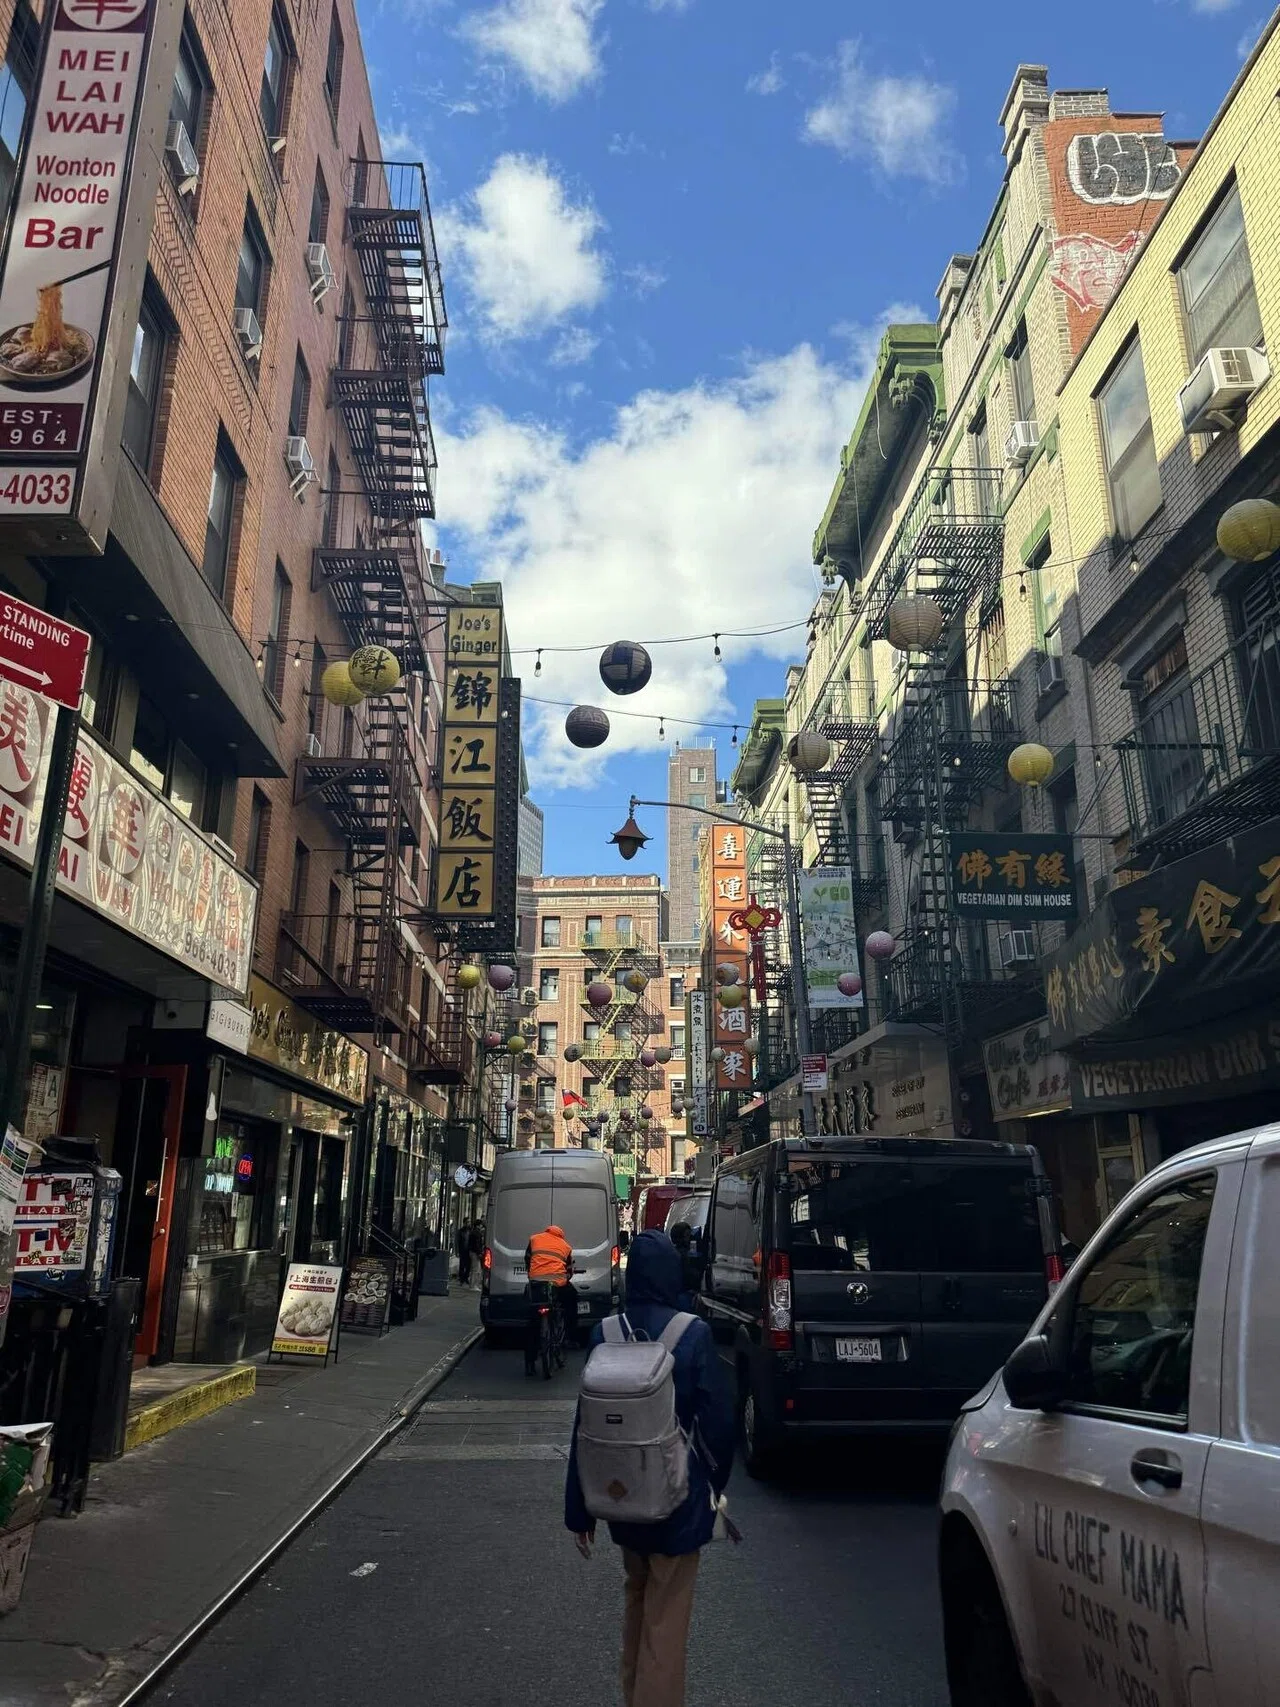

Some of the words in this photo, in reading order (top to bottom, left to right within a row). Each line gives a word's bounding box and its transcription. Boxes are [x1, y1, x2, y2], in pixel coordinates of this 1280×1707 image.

[58, 49, 130, 72] MEI
[56, 80, 122, 103] LAI
[47, 111, 125, 135] WAH
[37, 155, 116, 177] Wonton
[34, 182, 110, 204] Noodle
[24, 218, 104, 250] Bar
[3, 409, 62, 424] EST:
[3, 604, 71, 647] STANDING
[457, 612, 492, 632] Joe's
[450, 634, 497, 656] Ginger
[442, 671, 494, 908] 錦江飯店
[57, 846, 79, 883] AI
[957, 849, 1072, 890] 佛有緣
[957, 892, 1006, 905] VEGETARIAN
[1008, 894, 1023, 906] DIM
[1024, 894, 1041, 906] SUM
[1043, 894, 1072, 906] HOUSE
[184, 931, 237, 982] 966-4033
[1079, 1053, 1210, 1098] VEGETARIAN
[1211, 1030, 1267, 1081] DIM
[1035, 1501, 1058, 1564] LIL
[1064, 1511, 1110, 1585] CHEF
[1121, 1531, 1189, 1631] MAMA
